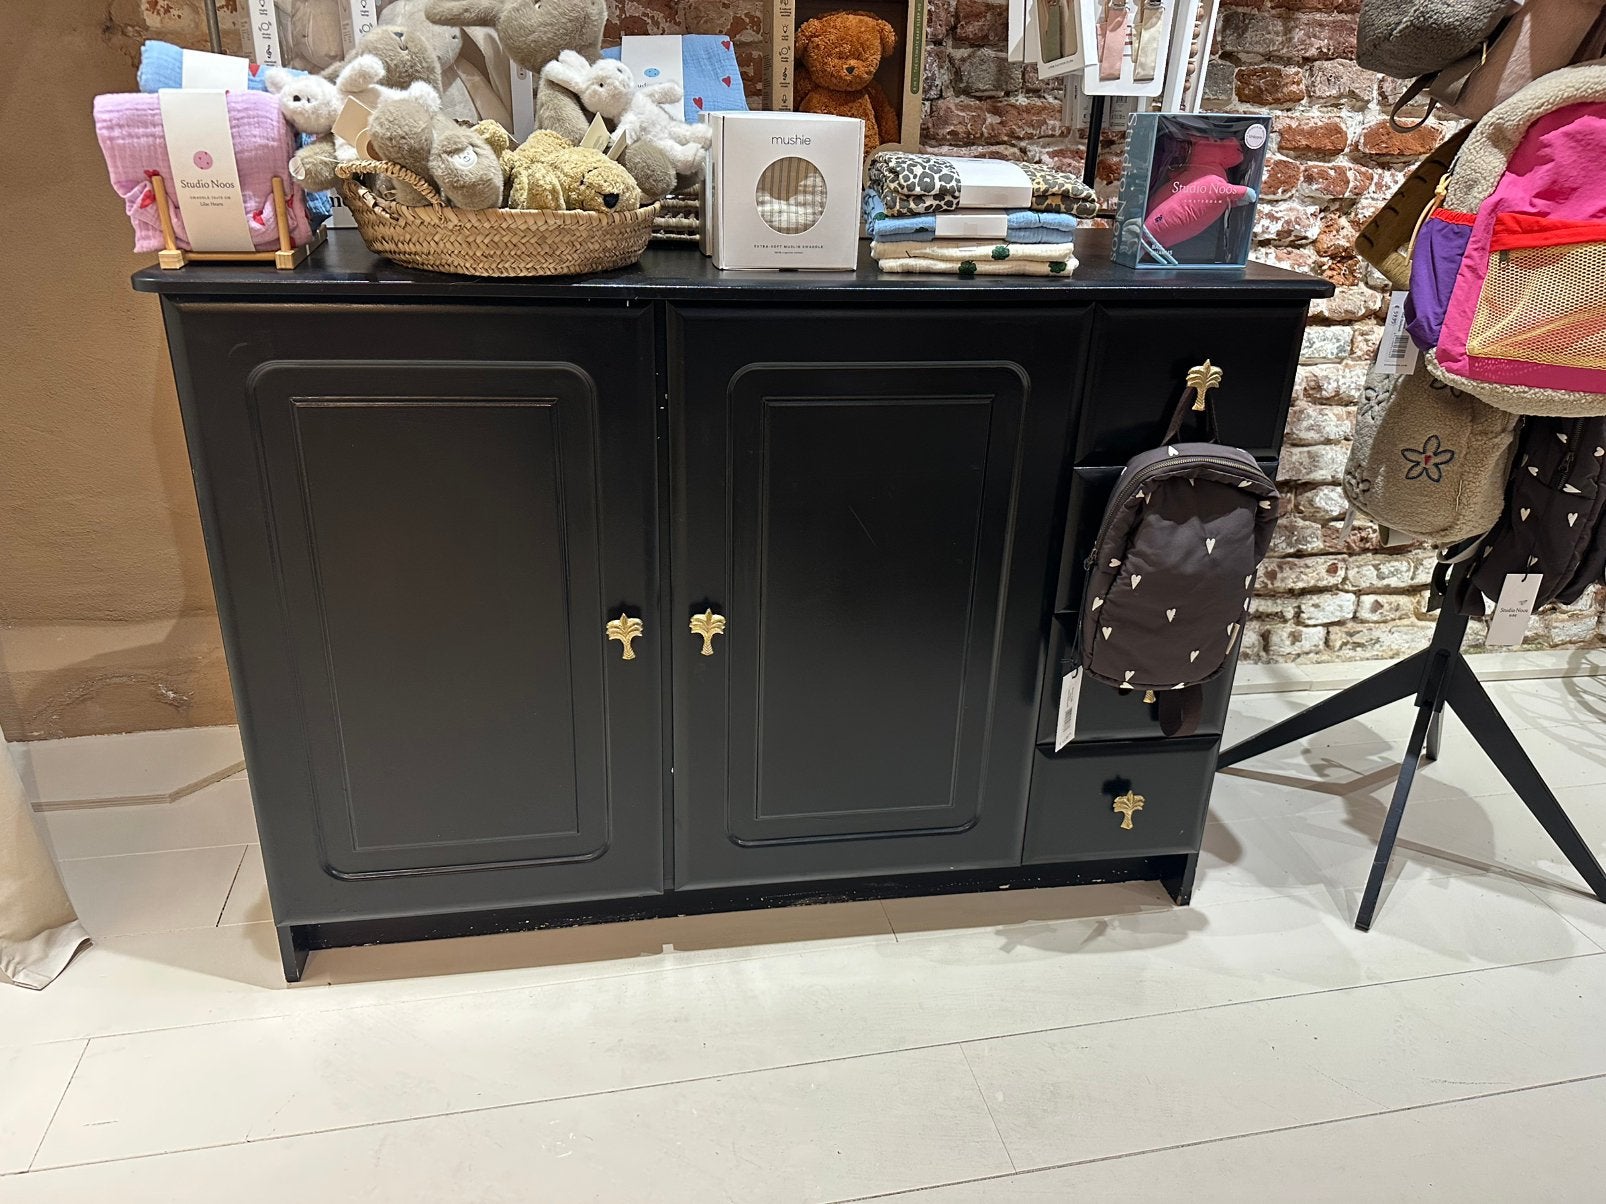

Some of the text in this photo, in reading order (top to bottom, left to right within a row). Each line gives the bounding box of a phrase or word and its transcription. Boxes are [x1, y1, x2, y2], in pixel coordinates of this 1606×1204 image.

[771, 134, 812, 146] mushie
[180, 179, 236, 190] Studio Noos
[1110, 113, 1138, 262] Studio Noos
[1171, 181, 1238, 195] Studio Noos
